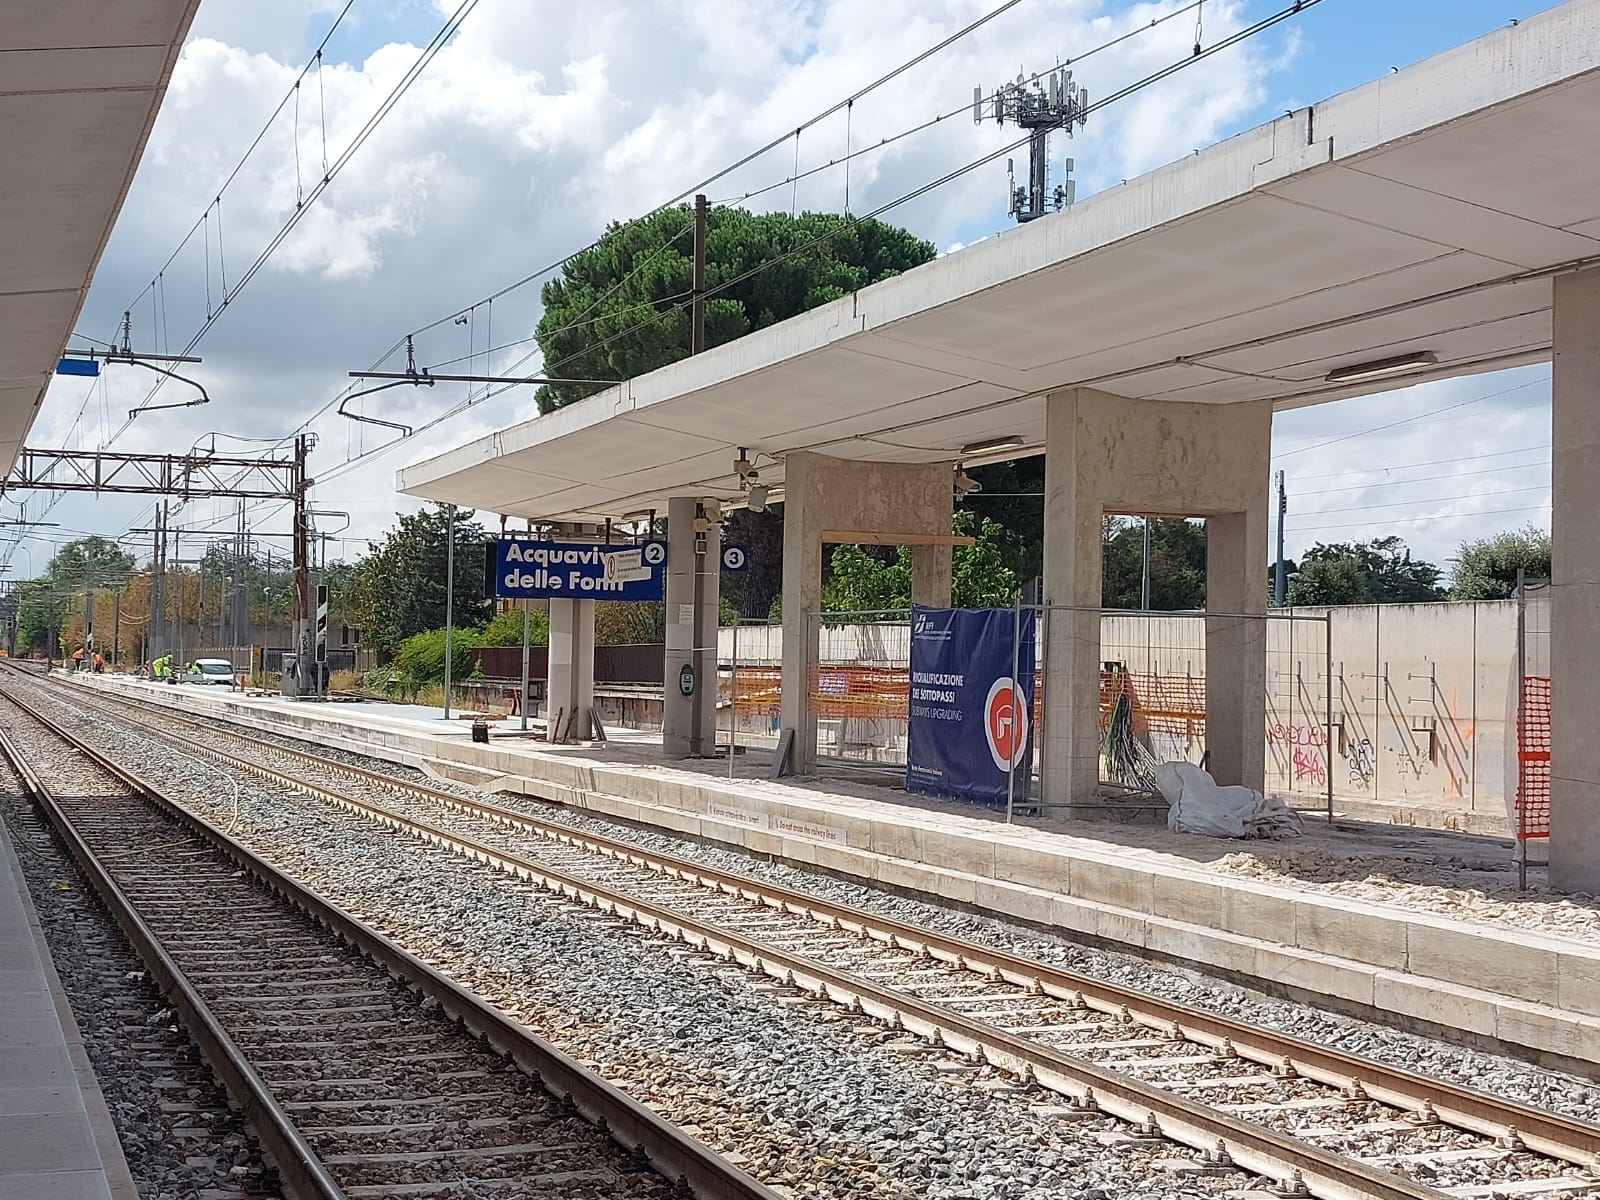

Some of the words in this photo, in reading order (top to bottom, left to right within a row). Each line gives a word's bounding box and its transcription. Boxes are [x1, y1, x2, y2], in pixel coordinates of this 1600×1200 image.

[505, 543, 607, 568] Acquaviv
[650, 547, 660, 560] 2
[729, 551, 739, 565] 3
[504, 568, 563, 590] delle
[920, 688, 955, 703] SOTTOPASSI
